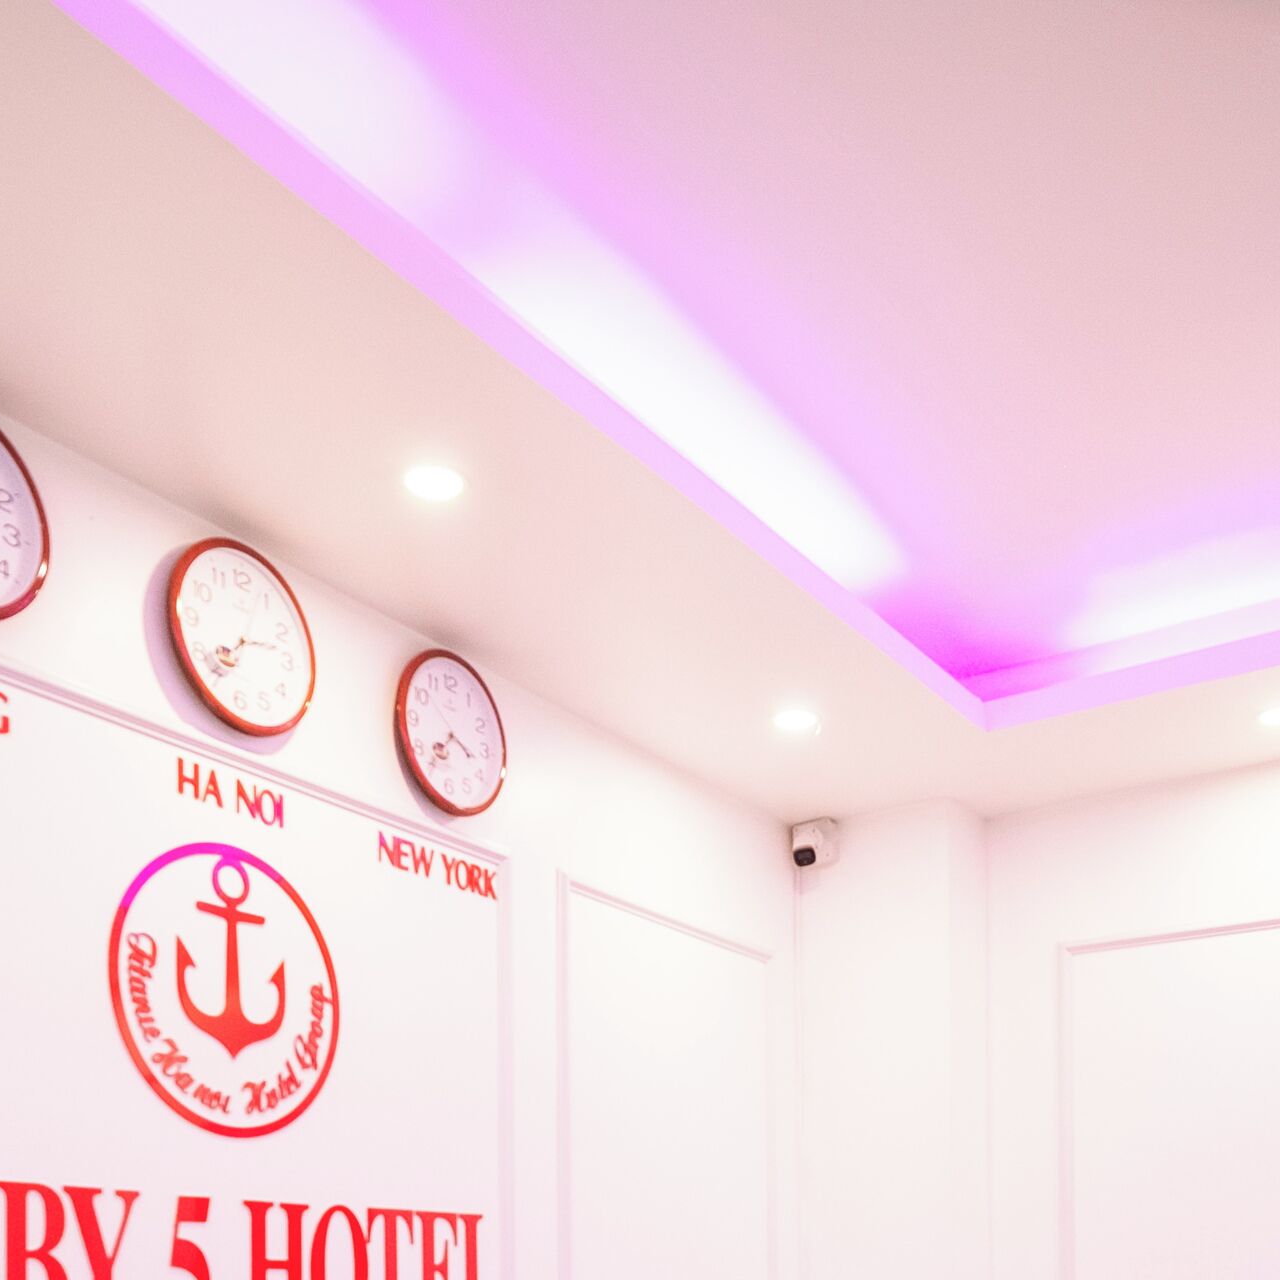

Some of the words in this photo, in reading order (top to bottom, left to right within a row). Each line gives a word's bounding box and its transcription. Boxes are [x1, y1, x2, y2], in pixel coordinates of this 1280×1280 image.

[2, 523, 21, 547] 3
[212, 567, 226, 589] 11
[233, 568, 252, 592] 12
[193, 579, 213, 603] 10
[185, 607, 199, 627] 9
[275, 622, 289, 643] 2
[192, 641, 207, 662] 8
[281, 652, 294, 672] 3
[275, 682, 287, 698] 4
[428, 673, 439, 691] 11
[444, 673, 458, 694] 12
[233, 690, 247, 711] 6
[257, 691, 270, 712] 5
[414, 686, 429, 706] 10
[408, 709, 419, 726] 9
[475, 717, 486, 734] 2
[414, 739, 424, 756] 8
[480, 742, 489, 759] 3
[475, 768, 485, 782] 4
[177, 758, 223, 808] HA
[236, 779, 284, 828] NOI
[444, 778, 454, 795] 6
[462, 777, 471, 794] 5
[378, 831, 434, 878] NEW
[441, 853, 497, 901] YORK
[294, 983, 334, 1071] Group
